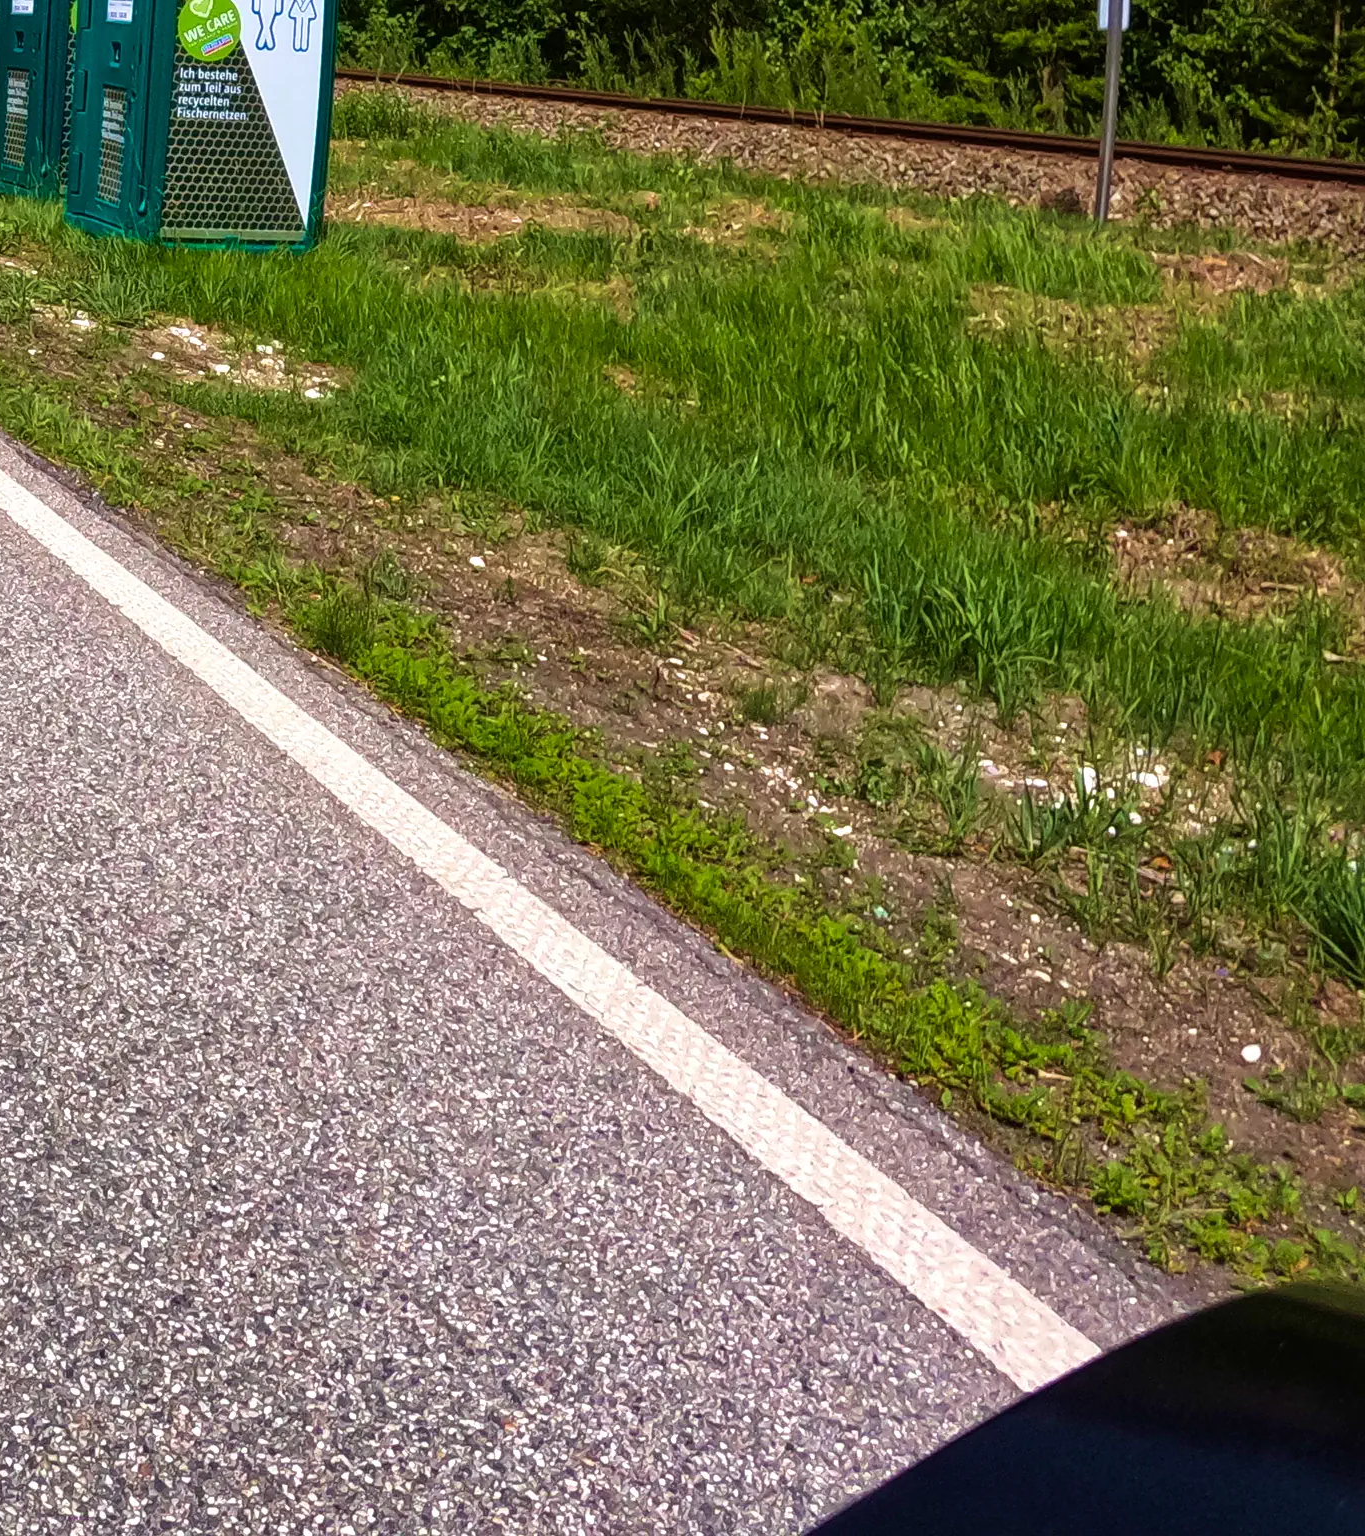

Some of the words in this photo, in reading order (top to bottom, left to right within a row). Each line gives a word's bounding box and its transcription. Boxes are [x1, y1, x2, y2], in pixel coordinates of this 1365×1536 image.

[184, 25, 205, 43] WE
[206, 9, 237, 33] CARE
[179, 67, 195, 80] Ich
[198, 68, 238, 82] bestehe
[178, 82, 201, 93] zum
[204, 81, 222, 94] Teil
[224, 84, 242, 95] aus
[177, 94, 230, 108] recycelten
